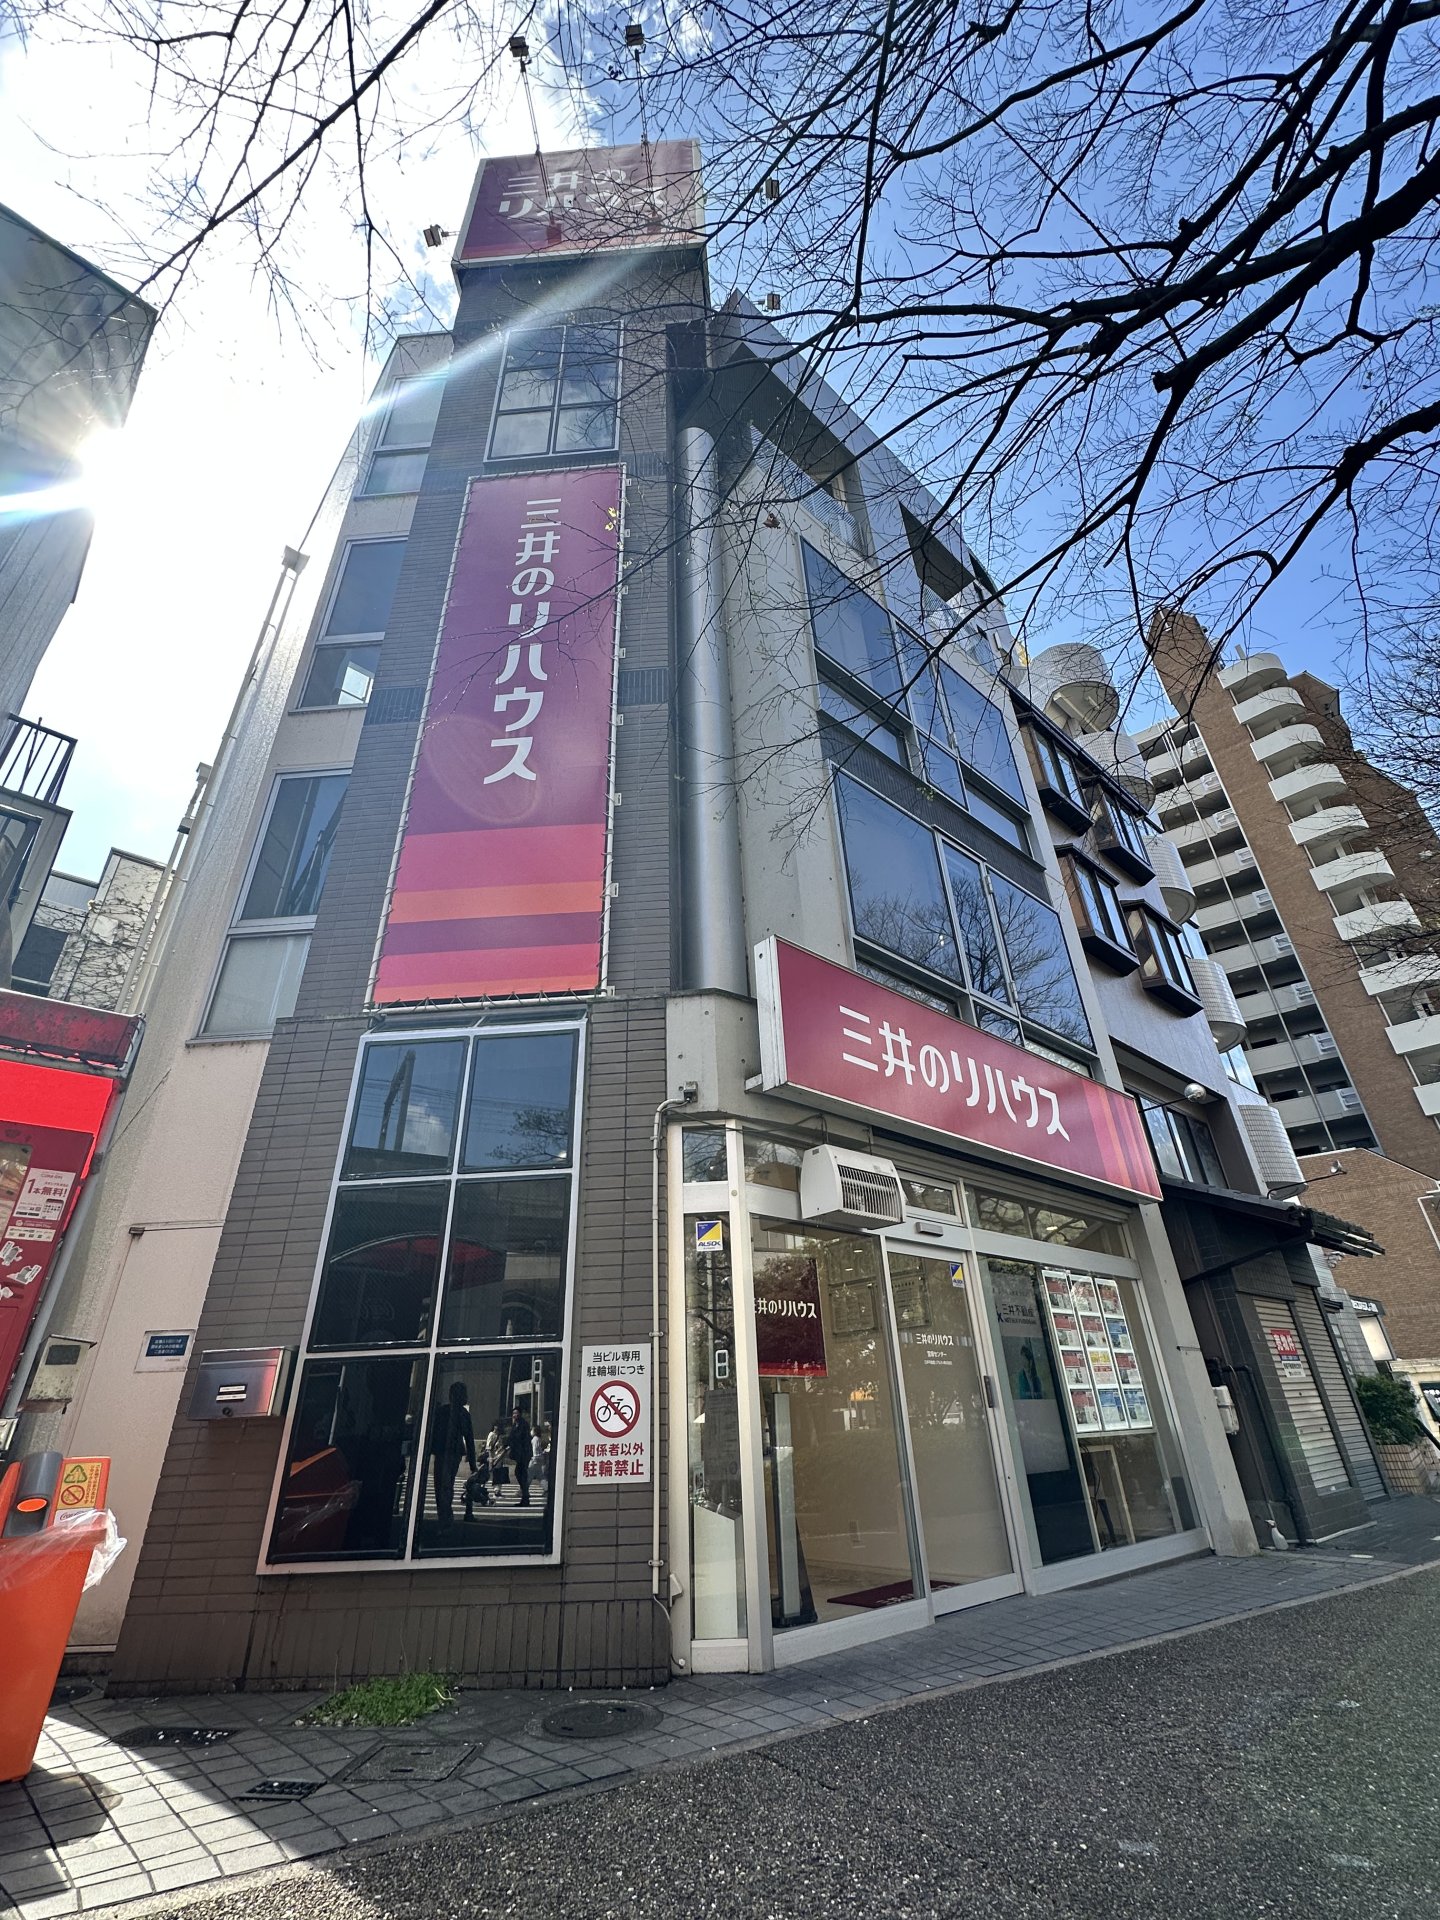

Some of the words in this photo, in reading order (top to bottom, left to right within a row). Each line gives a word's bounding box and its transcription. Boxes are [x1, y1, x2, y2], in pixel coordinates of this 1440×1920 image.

[502, 169, 626, 196] 三井の
[498, 186, 668, 219] リハウス
[483, 498, 562, 785] 三井のリハウス
[838, 1004, 1071, 1143] 三井のリハウス
[755, 1298, 817, 1318] 井のリハウス
[915, 1333, 954, 1346] 三井のリハウス
[592, 1350, 641, 1363] 当ビル専用
[586, 1364, 646, 1378] 駐輪場につき
[584, 1442, 645, 1458] 関係者以外
[582, 1458, 645, 1478] 駐輪禁止
